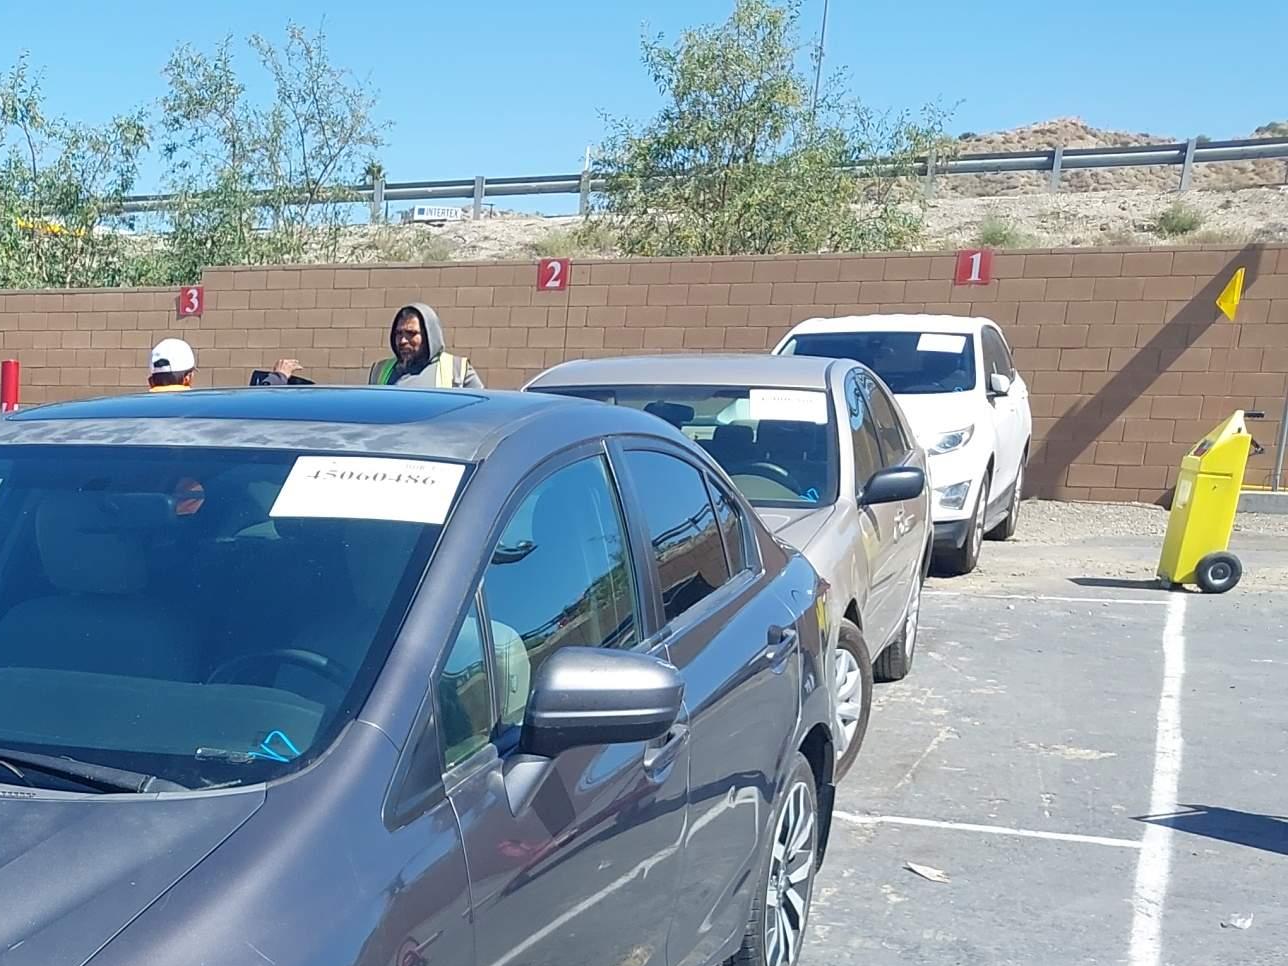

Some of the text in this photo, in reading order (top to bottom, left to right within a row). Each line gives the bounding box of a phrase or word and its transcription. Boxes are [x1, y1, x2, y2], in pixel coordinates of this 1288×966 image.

[545, 261, 561, 287] 2
[967, 252, 982, 281] 1
[185, 288, 199, 313] 3
